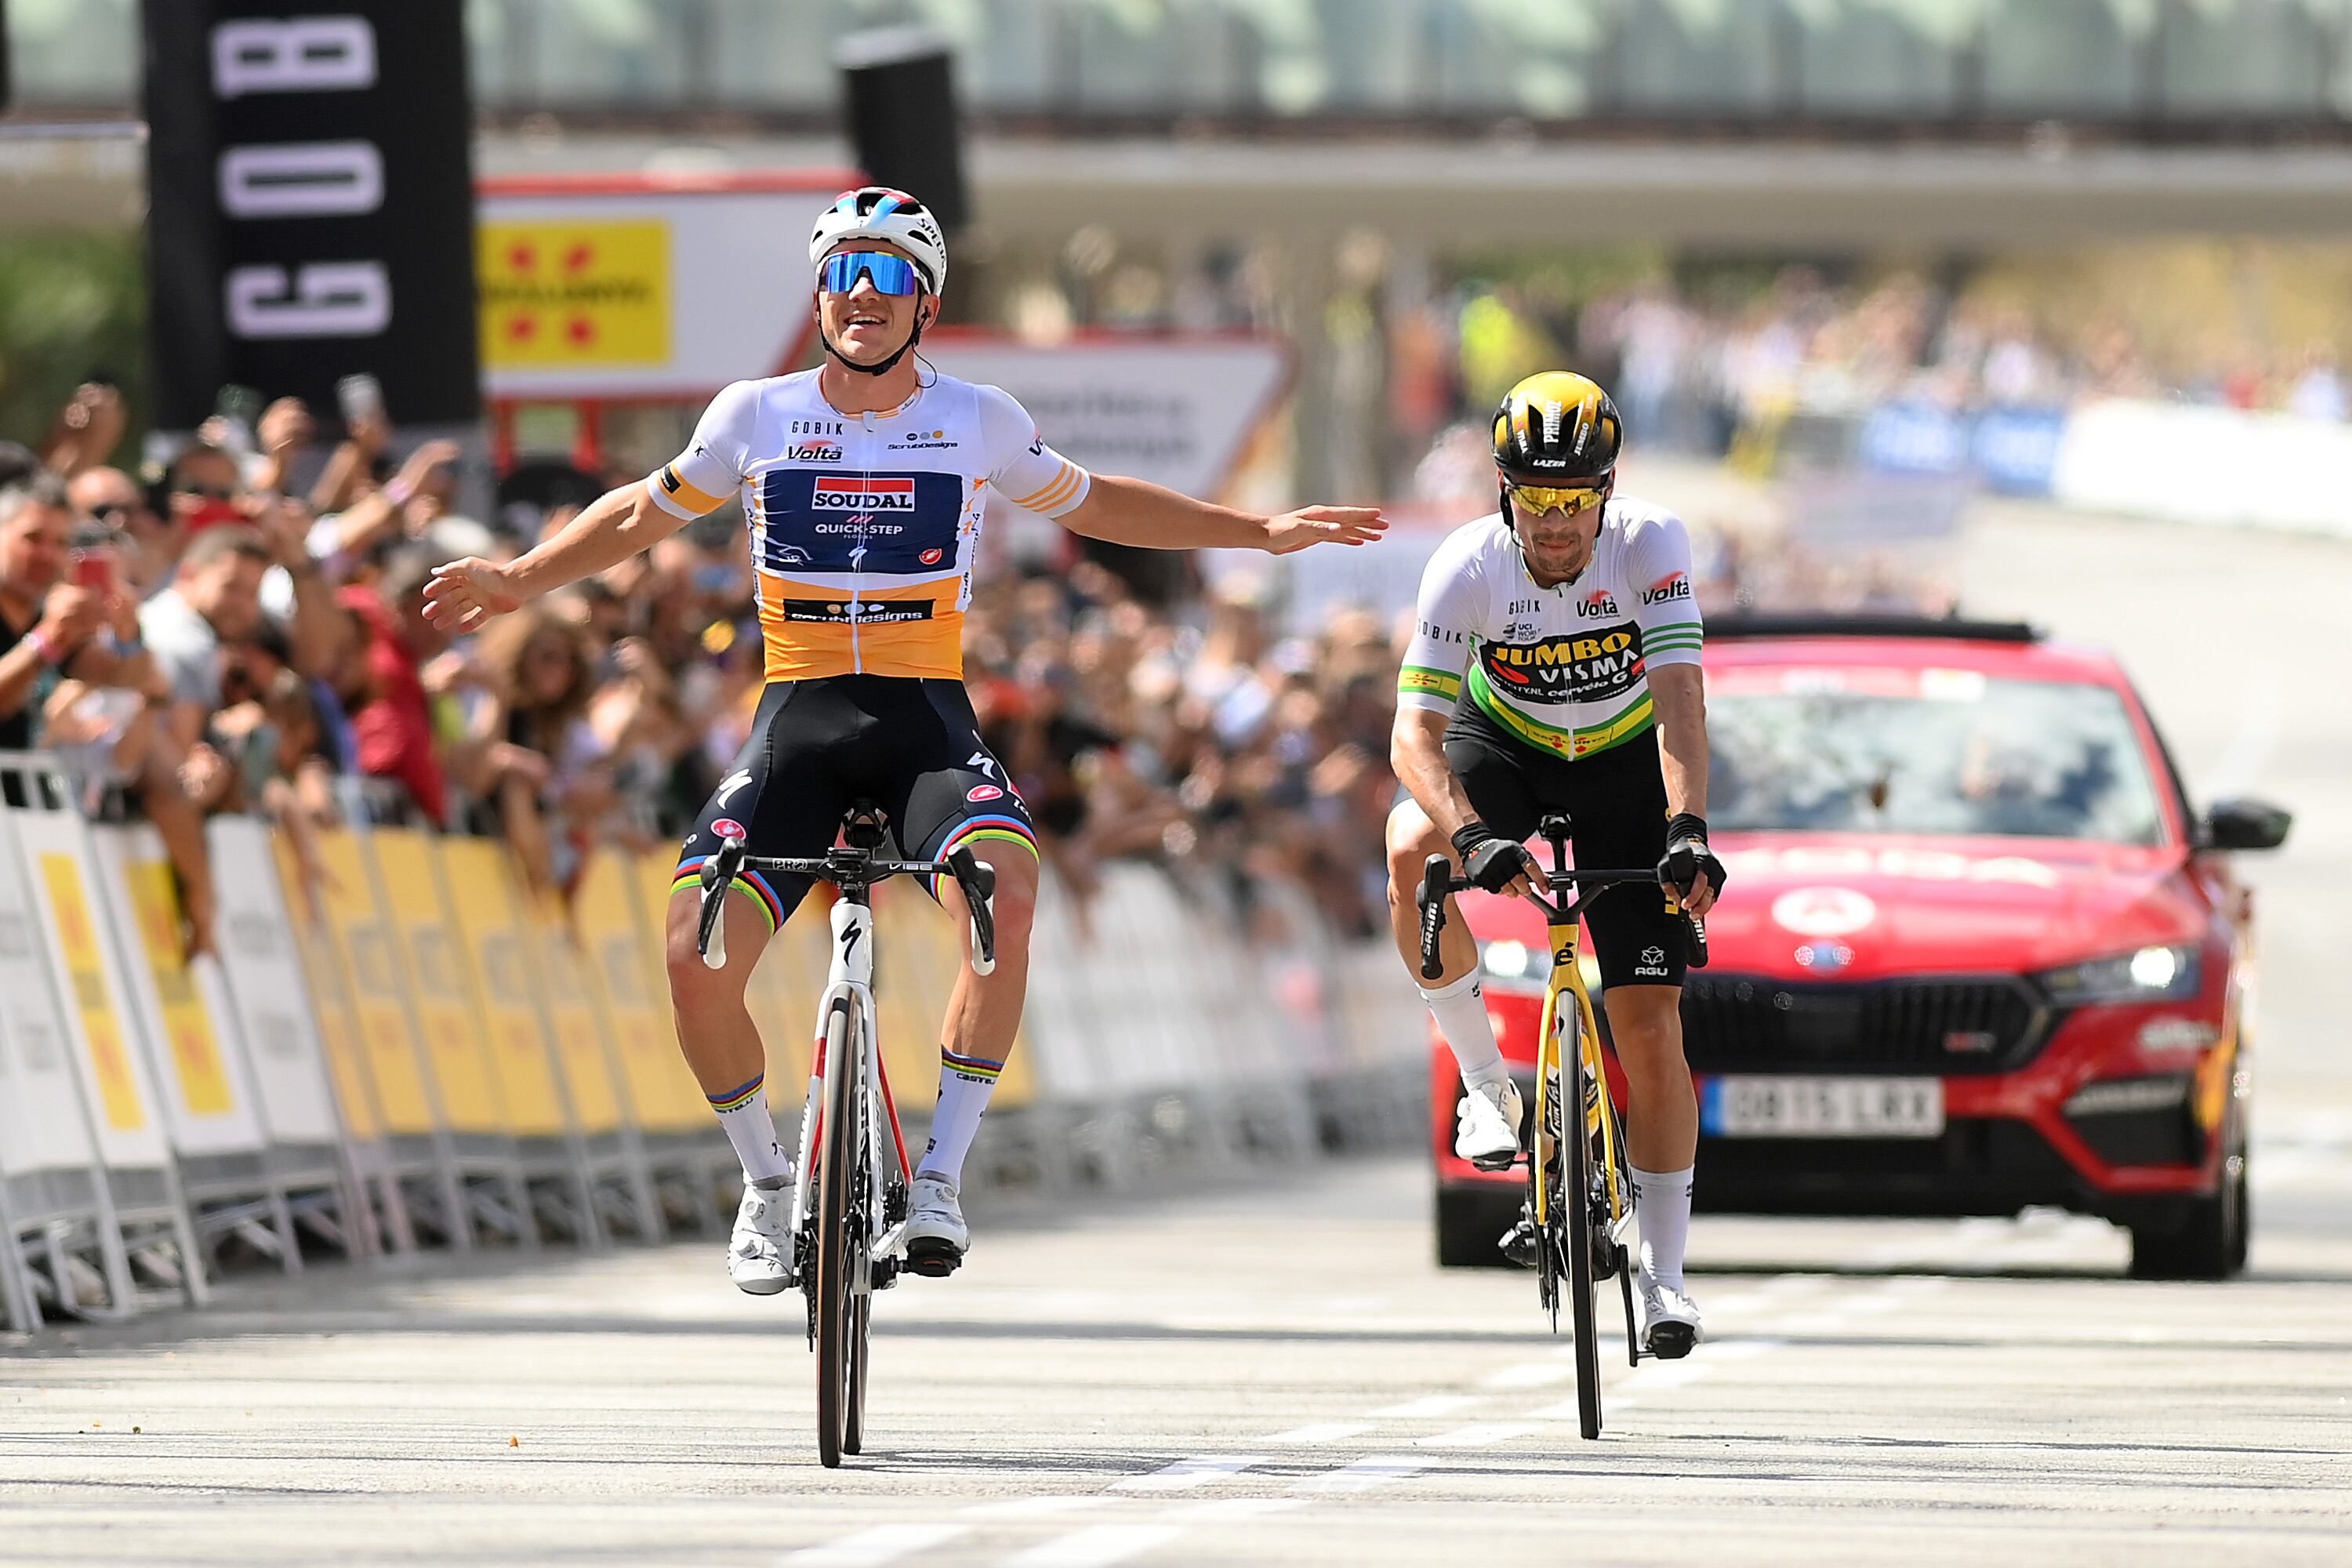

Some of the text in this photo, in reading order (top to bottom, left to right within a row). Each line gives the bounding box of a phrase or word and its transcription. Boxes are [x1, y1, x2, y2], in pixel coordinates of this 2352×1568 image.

[792, 421, 843, 435] GOBIK
[1533, 459, 1566, 468] LAZER
[814, 492, 913, 509] SOUDAL
[815, 524, 903, 535] QUICK-STEP
[1491, 633, 1632, 666] JUMBO
[1539, 648, 1639, 683] VISMA
[1423, 902, 1438, 956] SRAM
[1635, 967, 1668, 976] AGU
